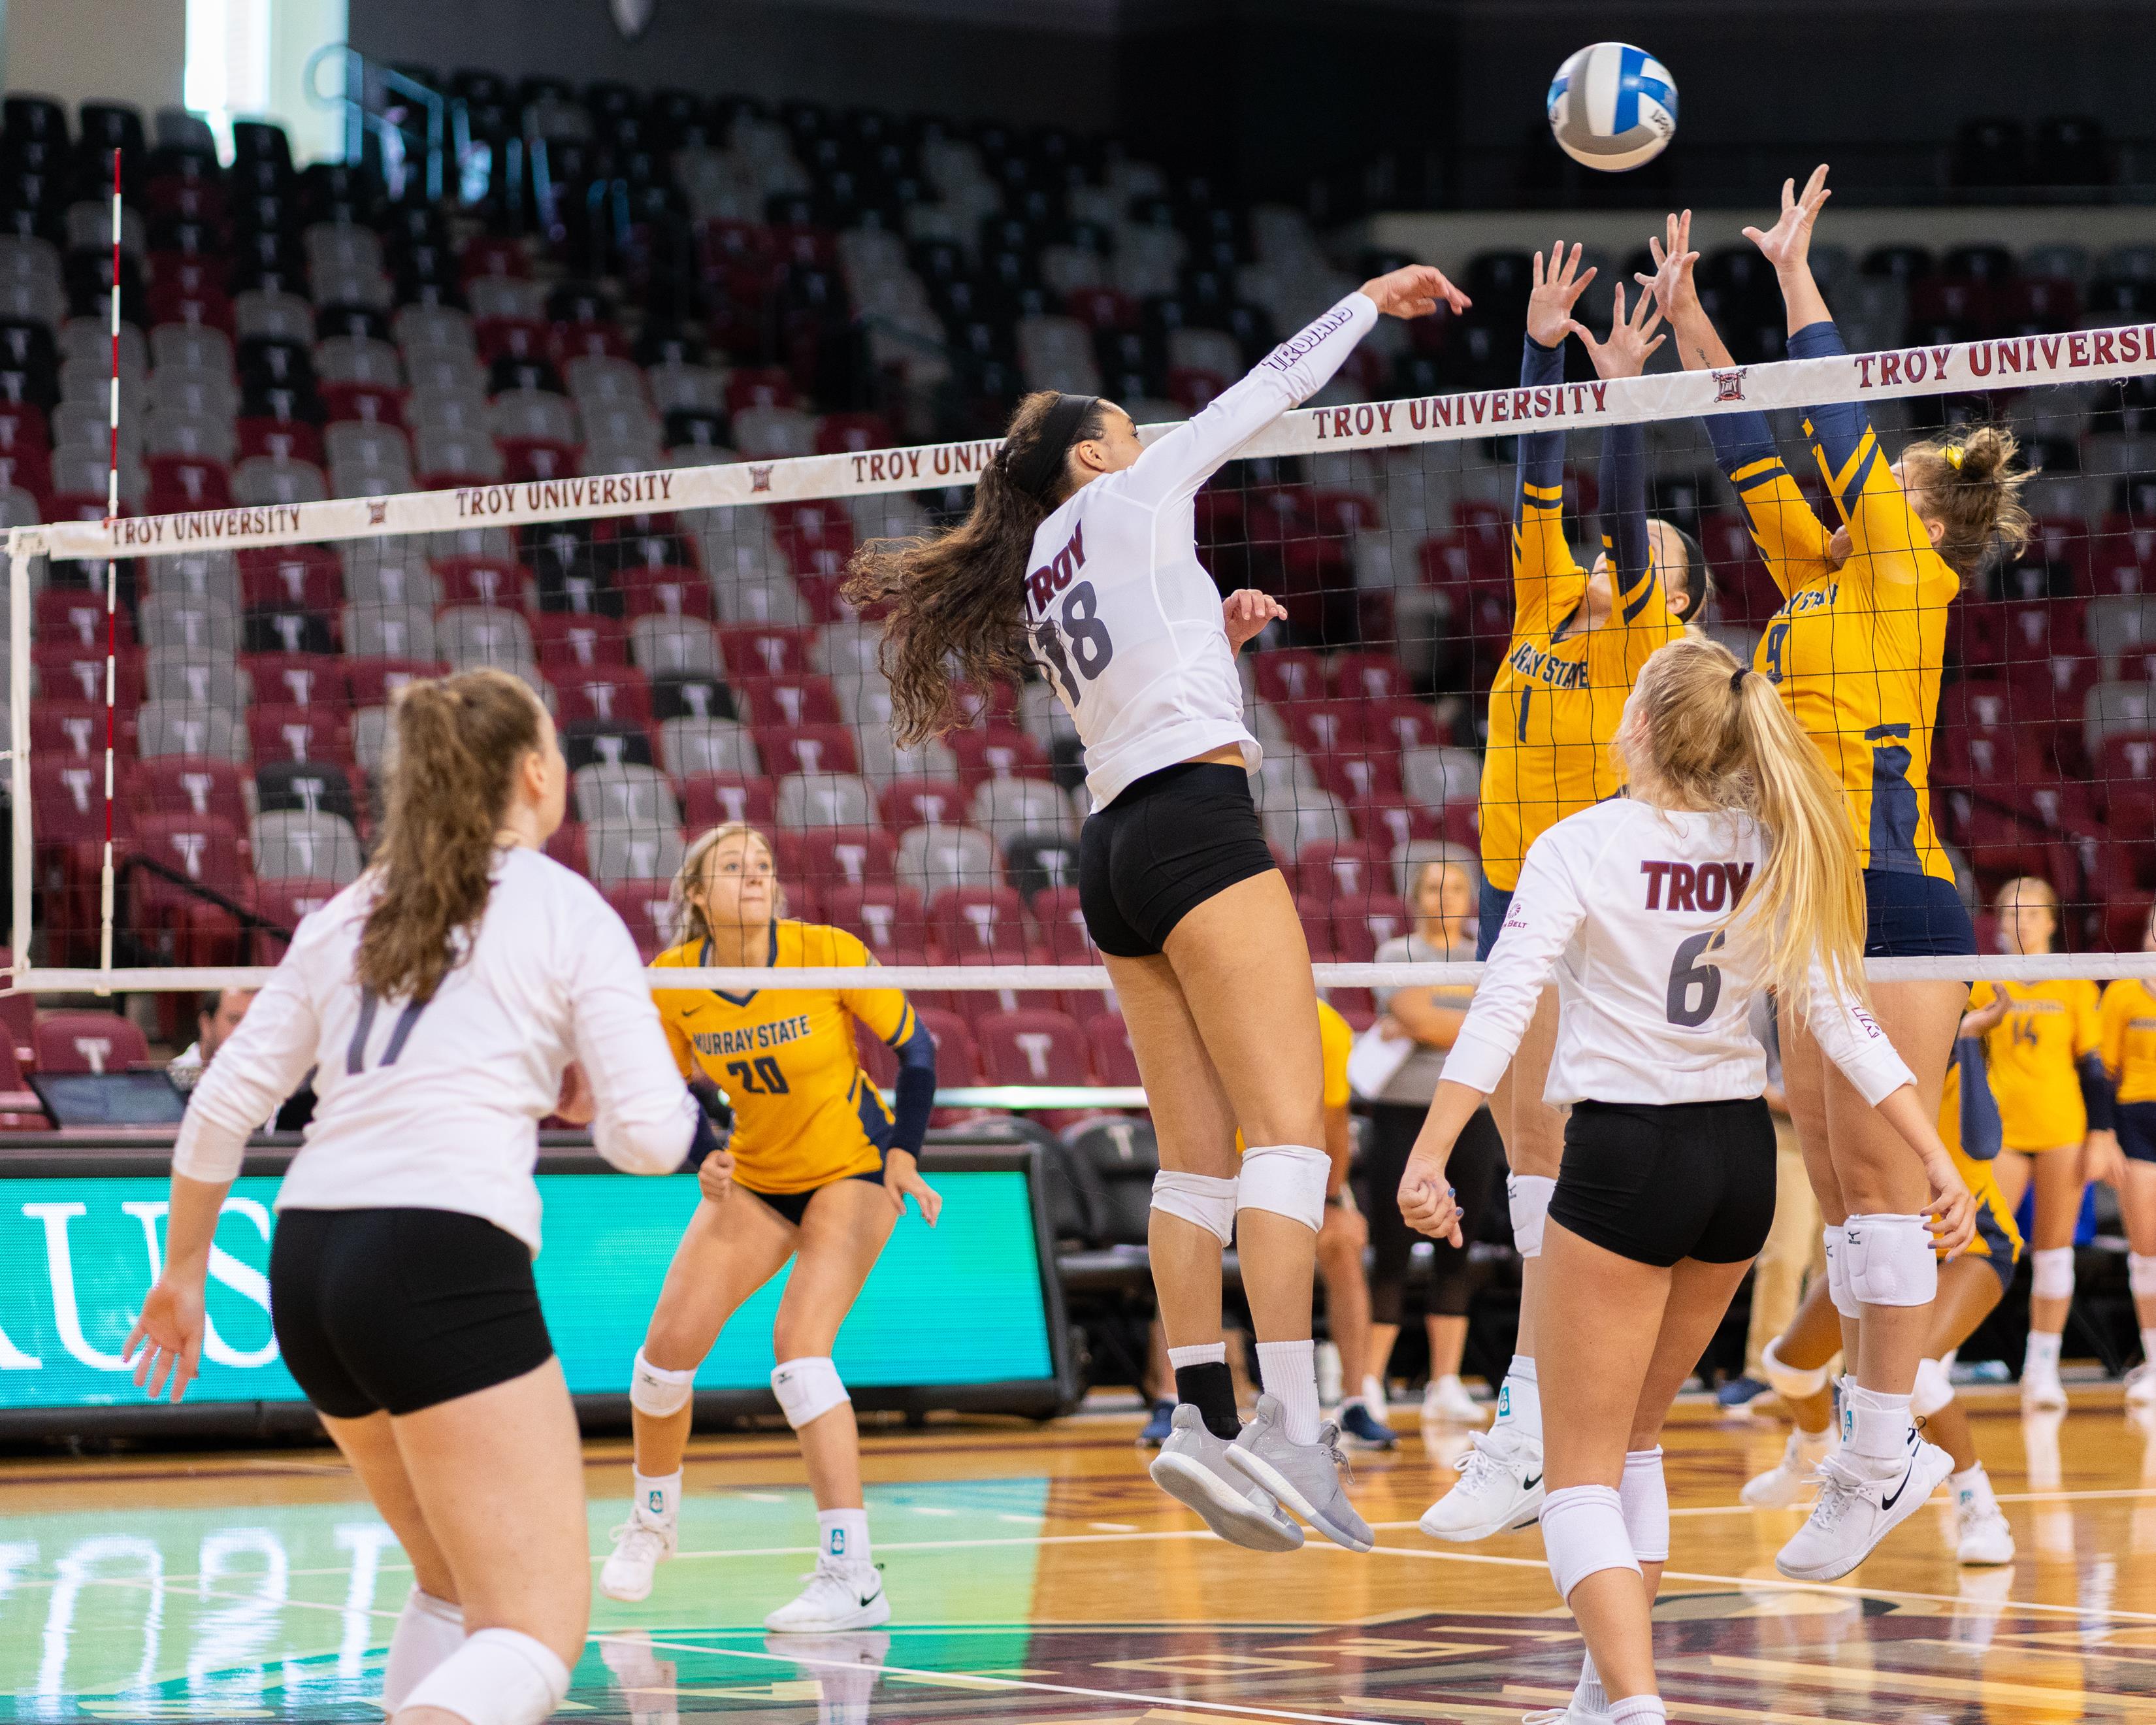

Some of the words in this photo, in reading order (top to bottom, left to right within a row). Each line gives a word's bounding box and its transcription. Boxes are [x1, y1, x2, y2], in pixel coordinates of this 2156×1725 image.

[1262, 307, 1353, 371] TROJANS
[1854, 346, 1953, 388] TROY
[1313, 402, 1394, 439] TROY
[1409, 382, 1609, 431] UNIVERSITY
[852, 448, 921, 483] TROY
[457, 485, 515, 516] TROY
[527, 472, 674, 510] UNIVERSITY
[113, 518, 164, 544] TROY
[174, 506, 301, 540] UNIVERSITY
[1024, 518, 1086, 627] TROY
[1036, 580, 1113, 708] 18
[1766, 623, 1791, 685] 9
[1543, 656, 1589, 688] STATE
[1519, 684, 1532, 743] 1
[1641, 860, 1755, 912] TROY
[1667, 930, 1725, 1028] 6
[693, 1027, 753, 1055] MURRAY
[757, 1014, 811, 1048] STATE
[727, 1056, 789, 1094] 20
